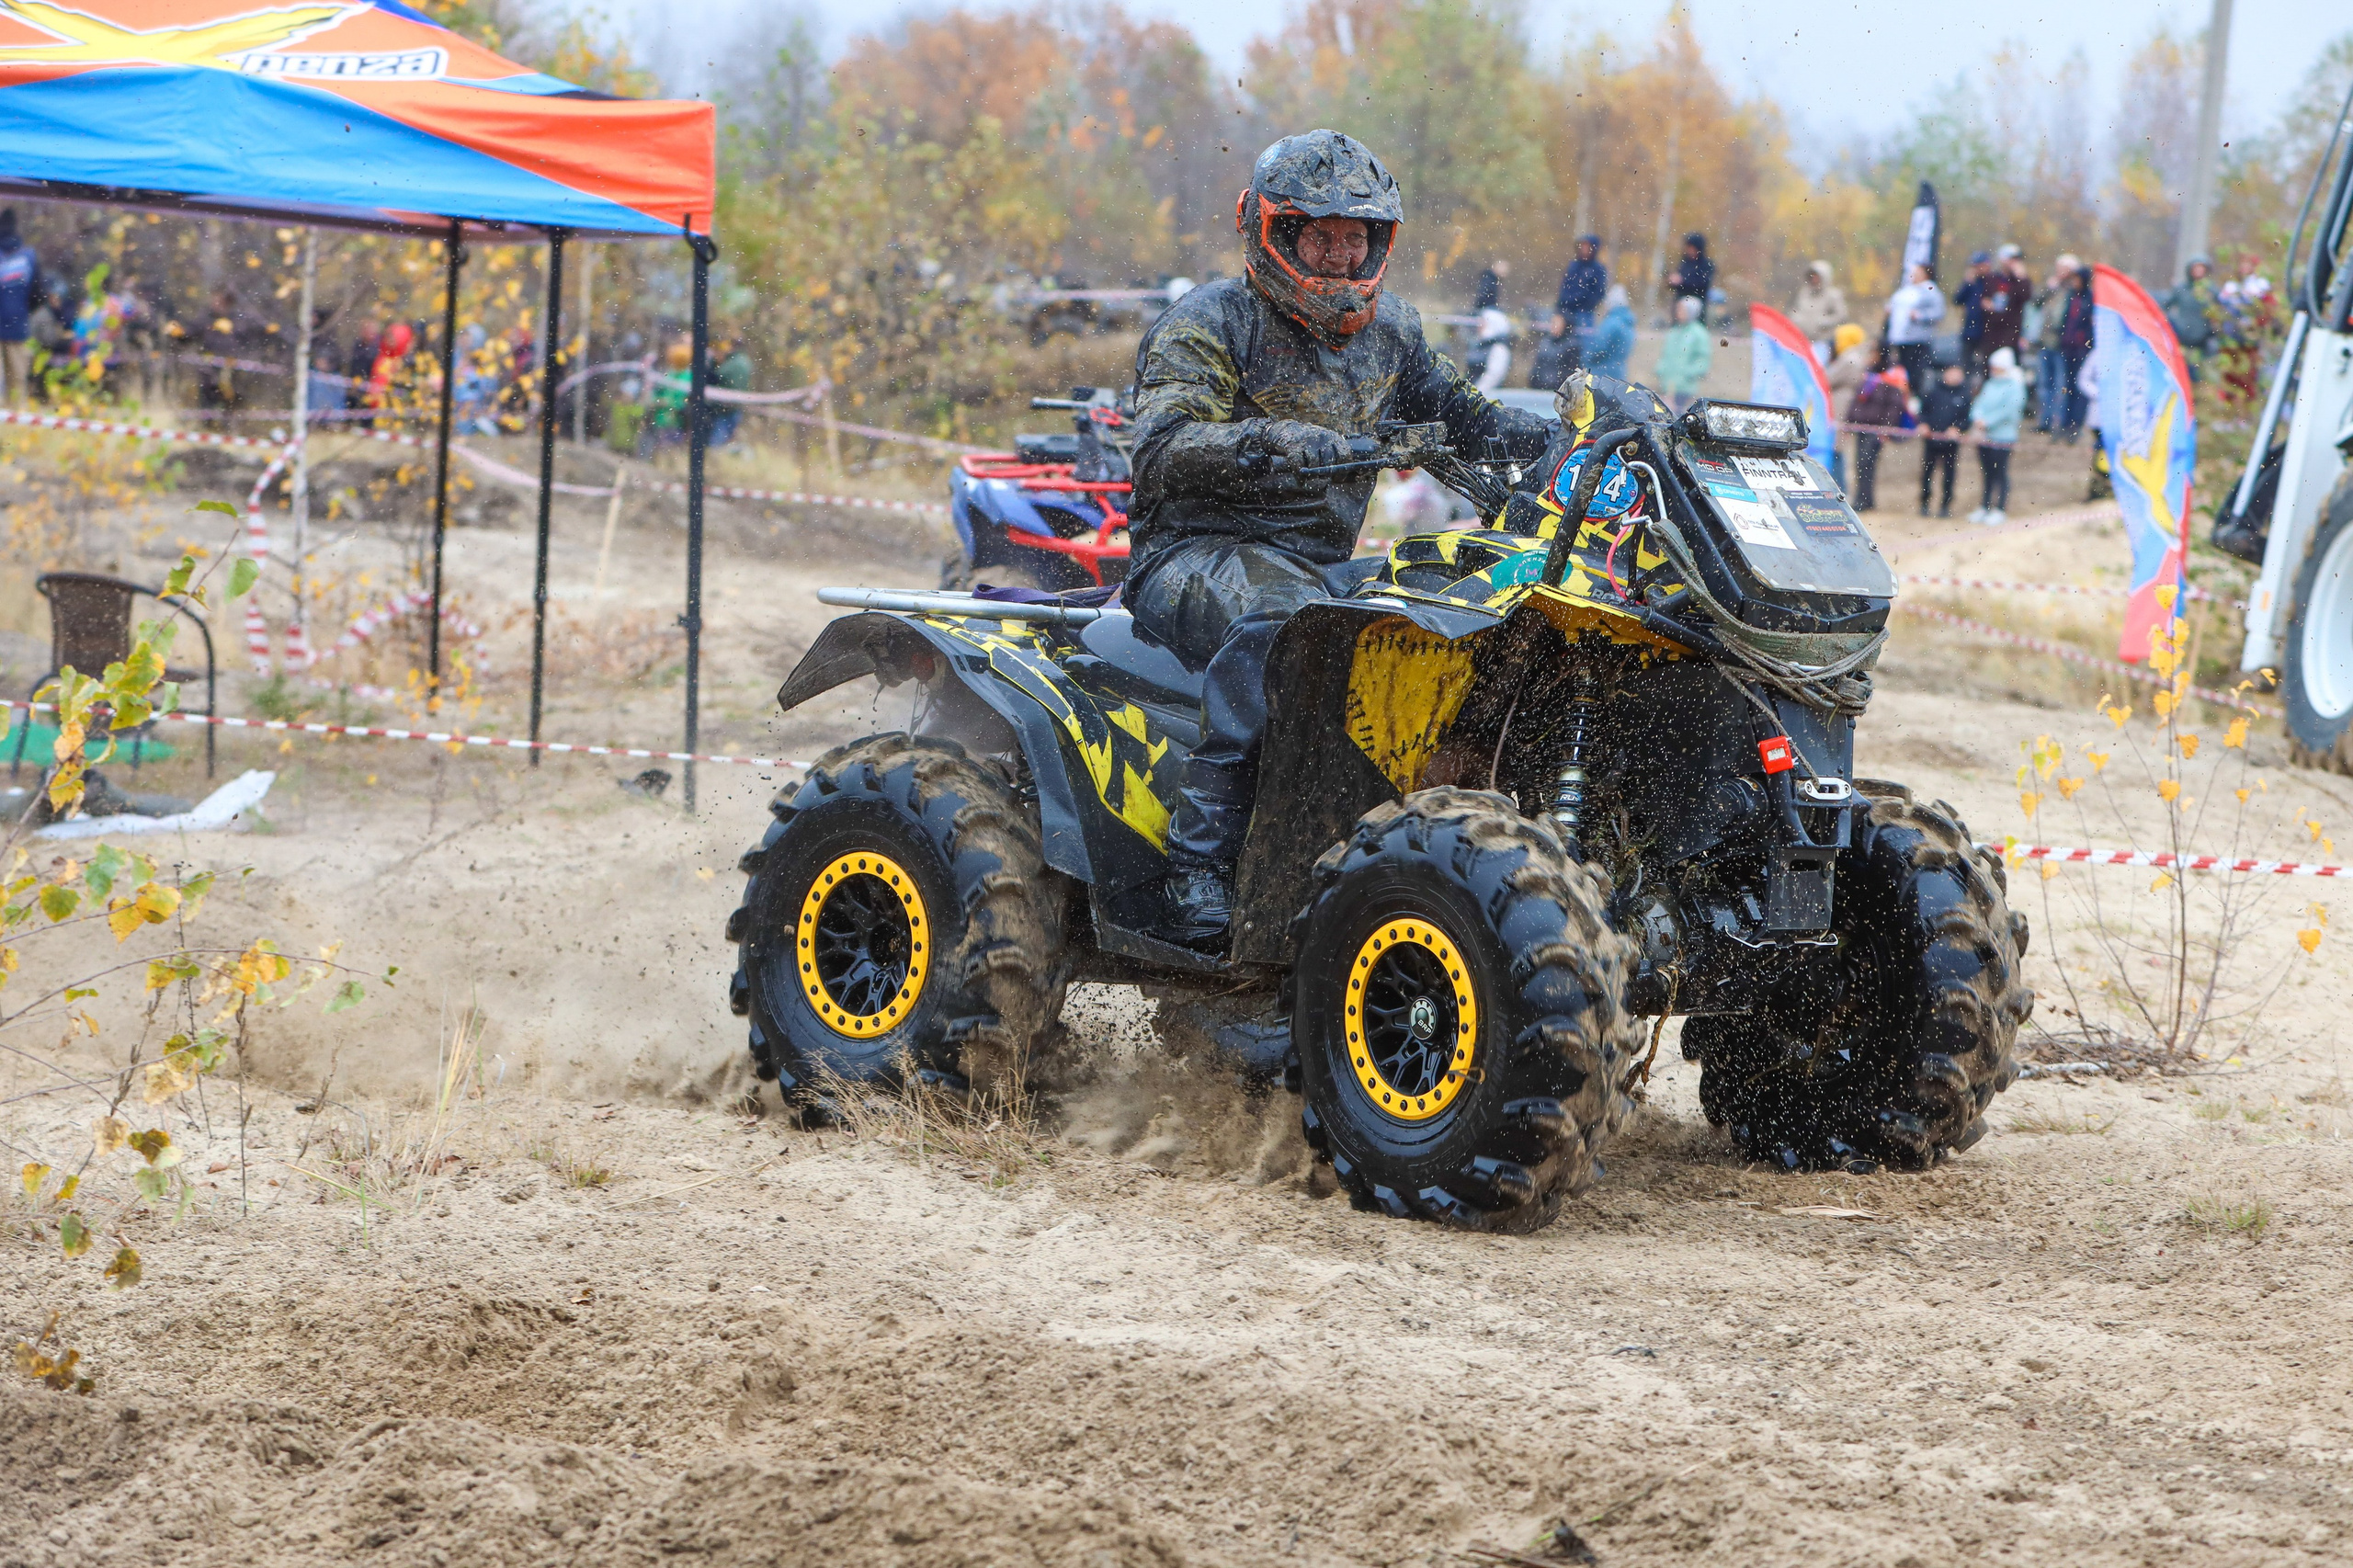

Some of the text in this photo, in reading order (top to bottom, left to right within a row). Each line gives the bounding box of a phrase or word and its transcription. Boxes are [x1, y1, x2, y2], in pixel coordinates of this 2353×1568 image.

[1742, 468, 1807, 479] FINNTRAL
[1568, 463, 1622, 504] 14
[1417, 1019, 1432, 1034] BRP
